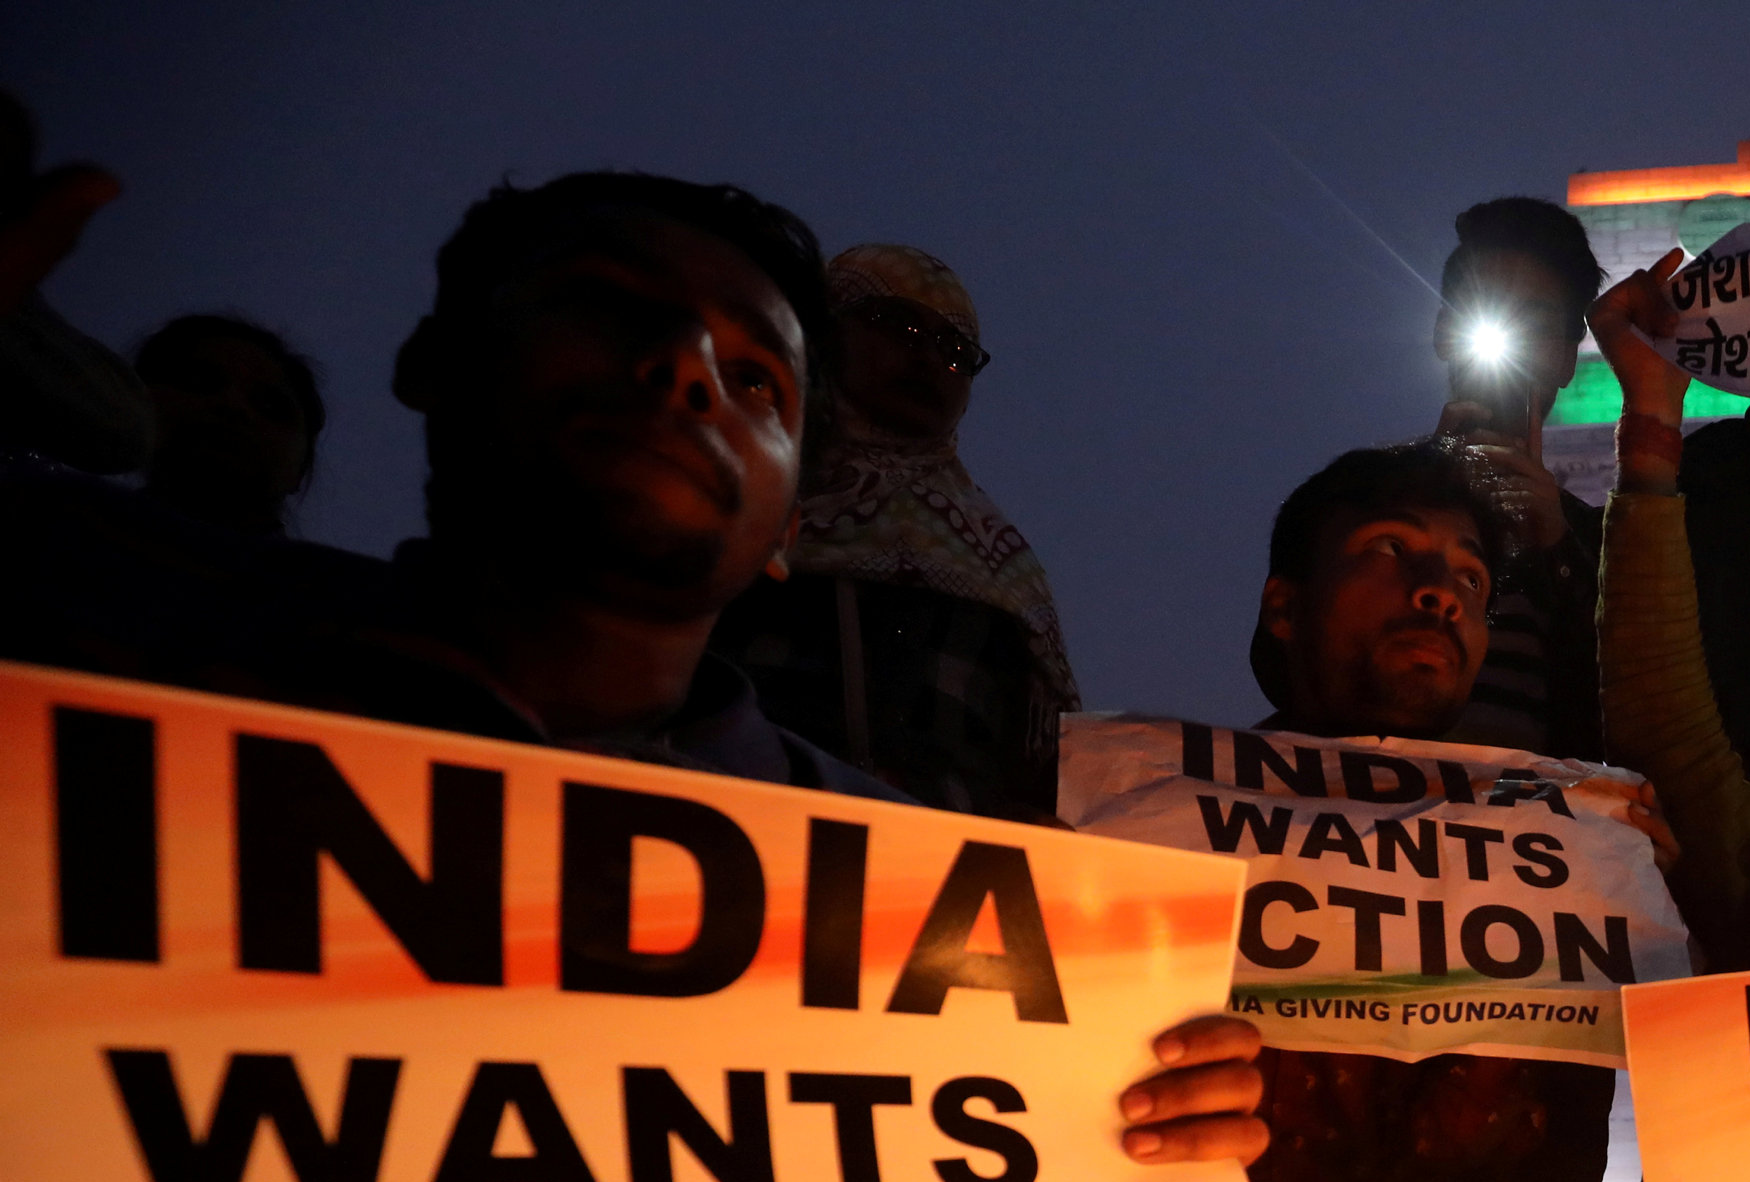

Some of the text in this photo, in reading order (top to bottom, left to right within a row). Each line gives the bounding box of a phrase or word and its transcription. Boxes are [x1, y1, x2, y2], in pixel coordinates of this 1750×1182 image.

[1181, 721, 1576, 818] INDIA
[51, 702, 1070, 1026] INDIA
[1195, 794, 1571, 889] WANTS
[1237, 880, 1637, 984] CTION
[1275, 998, 1391, 1022] GIVING
[1402, 1001, 1600, 1026] FOUNDATION
